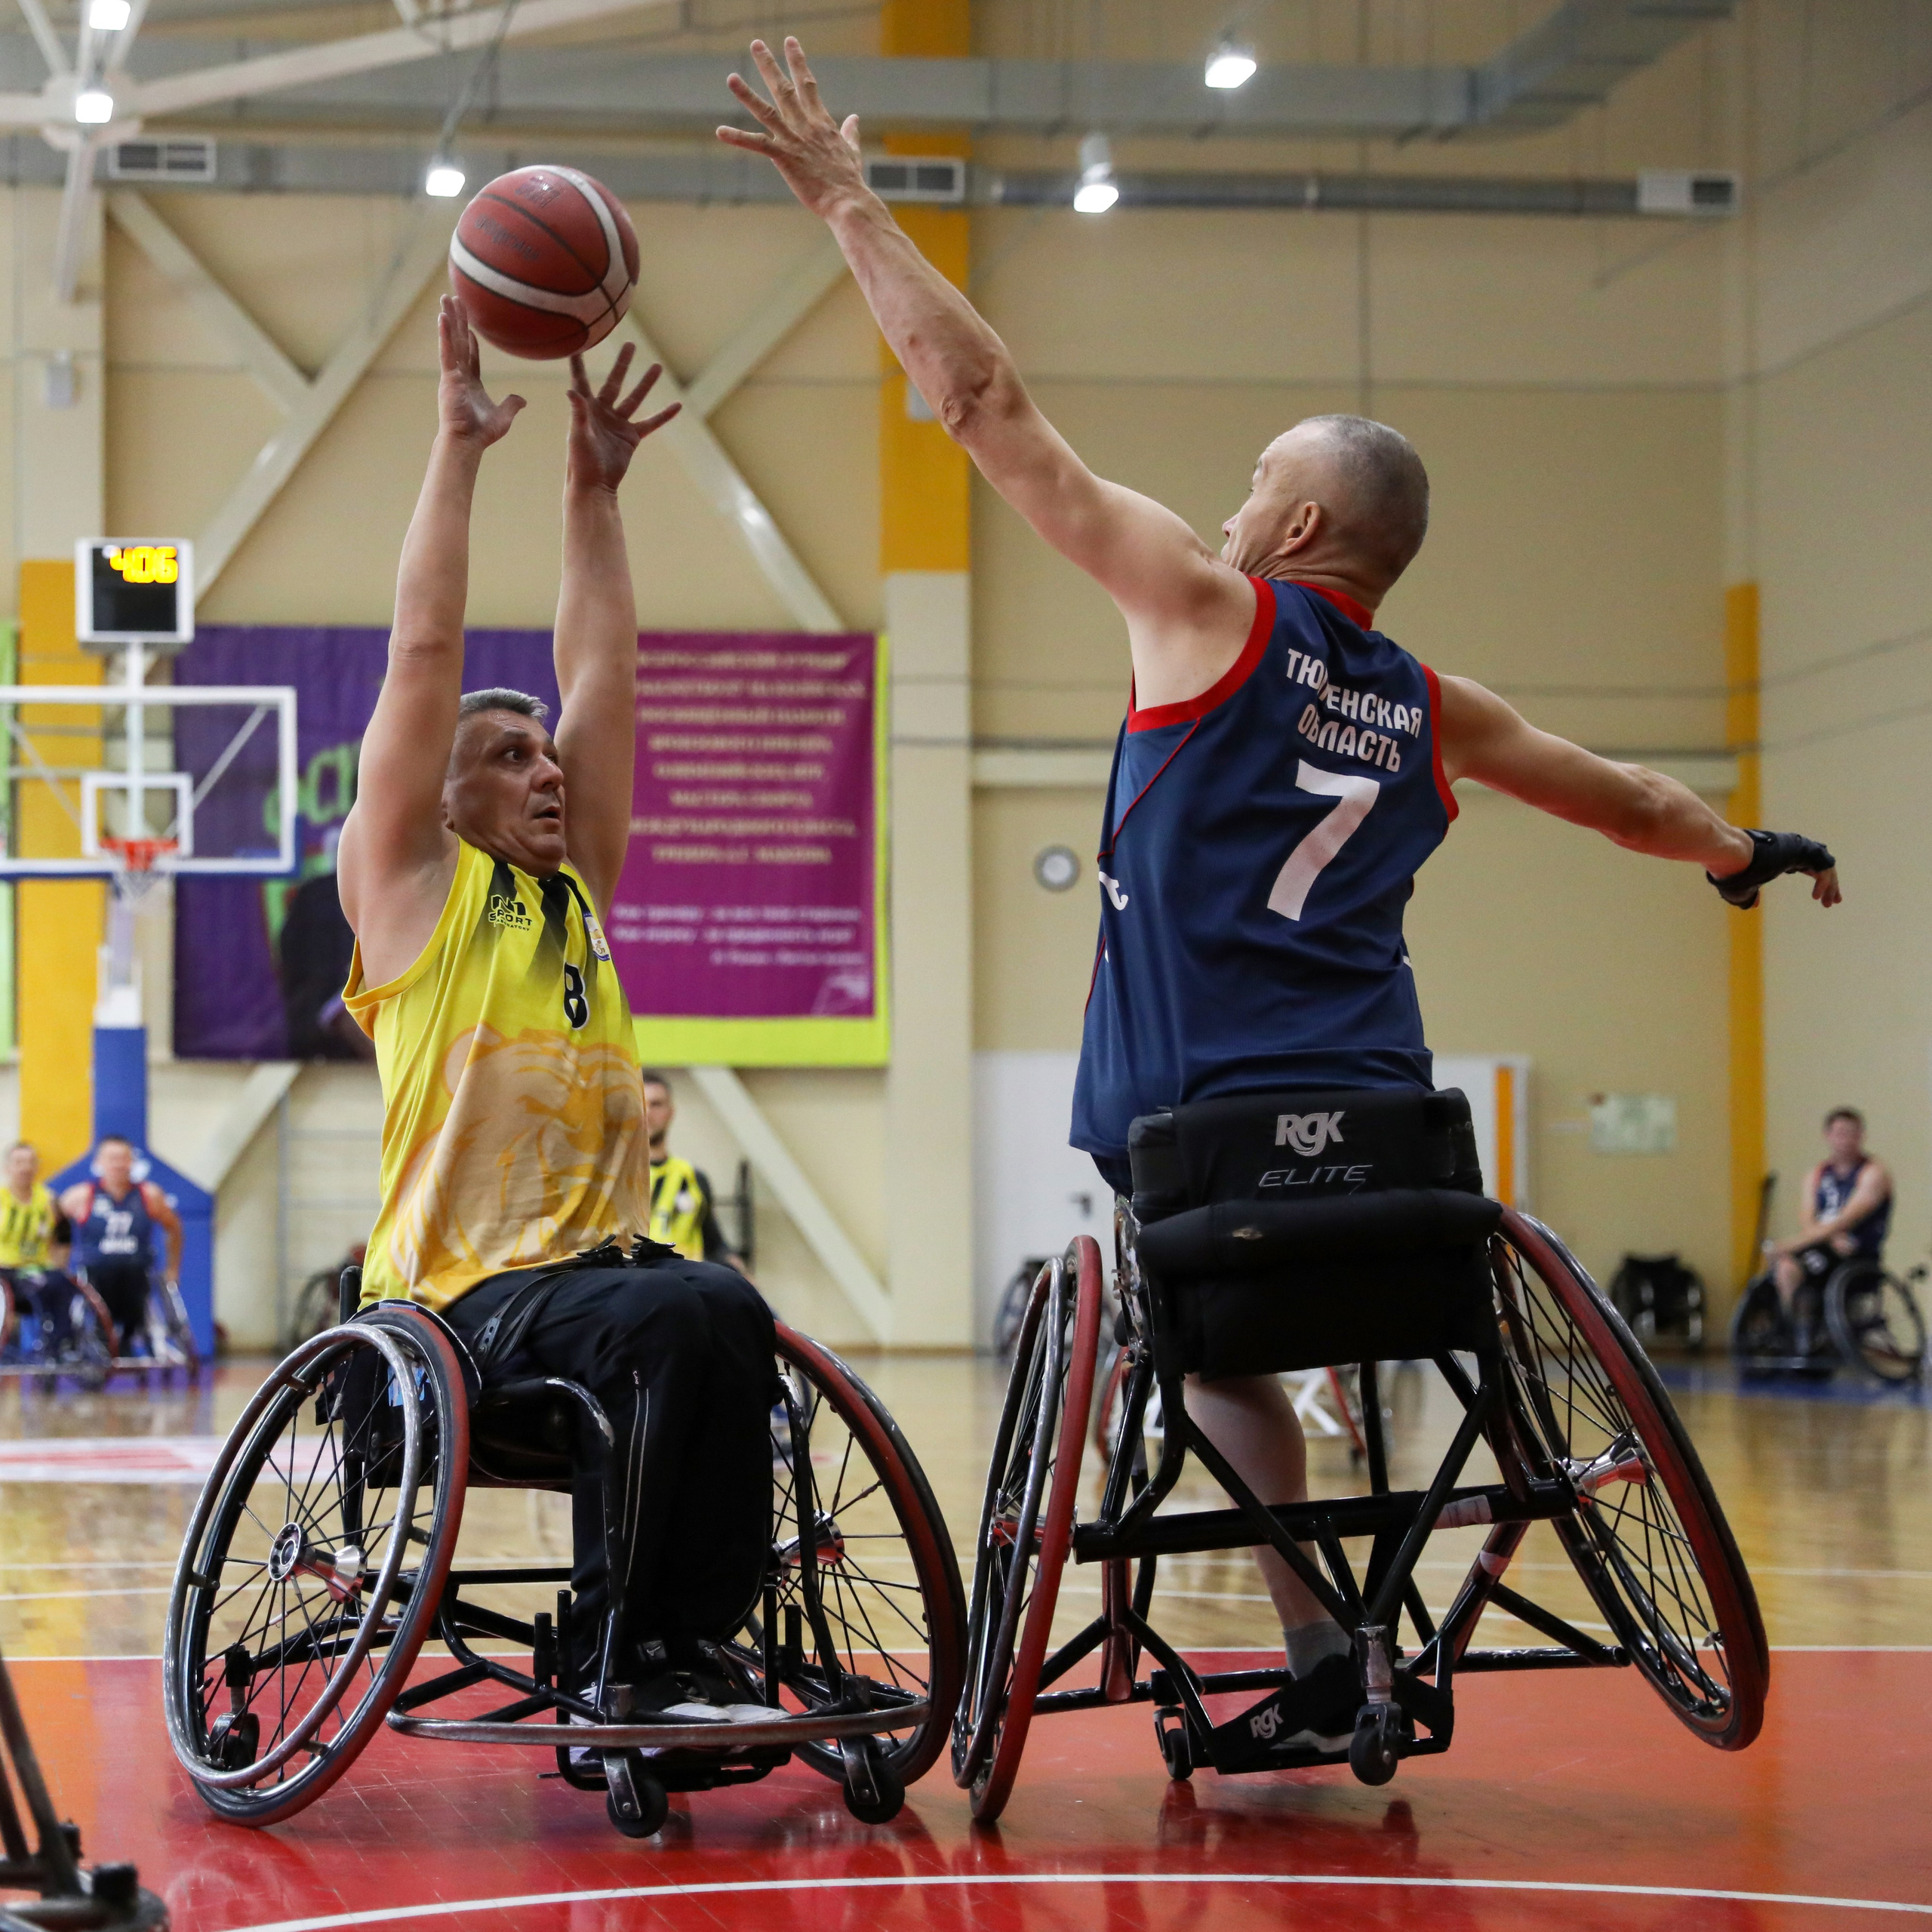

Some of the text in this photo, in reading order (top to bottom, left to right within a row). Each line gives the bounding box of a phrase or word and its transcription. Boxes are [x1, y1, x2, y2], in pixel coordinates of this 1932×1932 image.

[1297, 703, 1401, 773] ОБЛАСТЬ
[1267, 758, 1380, 921] 7
[488, 908, 533, 926] SPORT
[1258, 1164, 1374, 1195] ELITE
